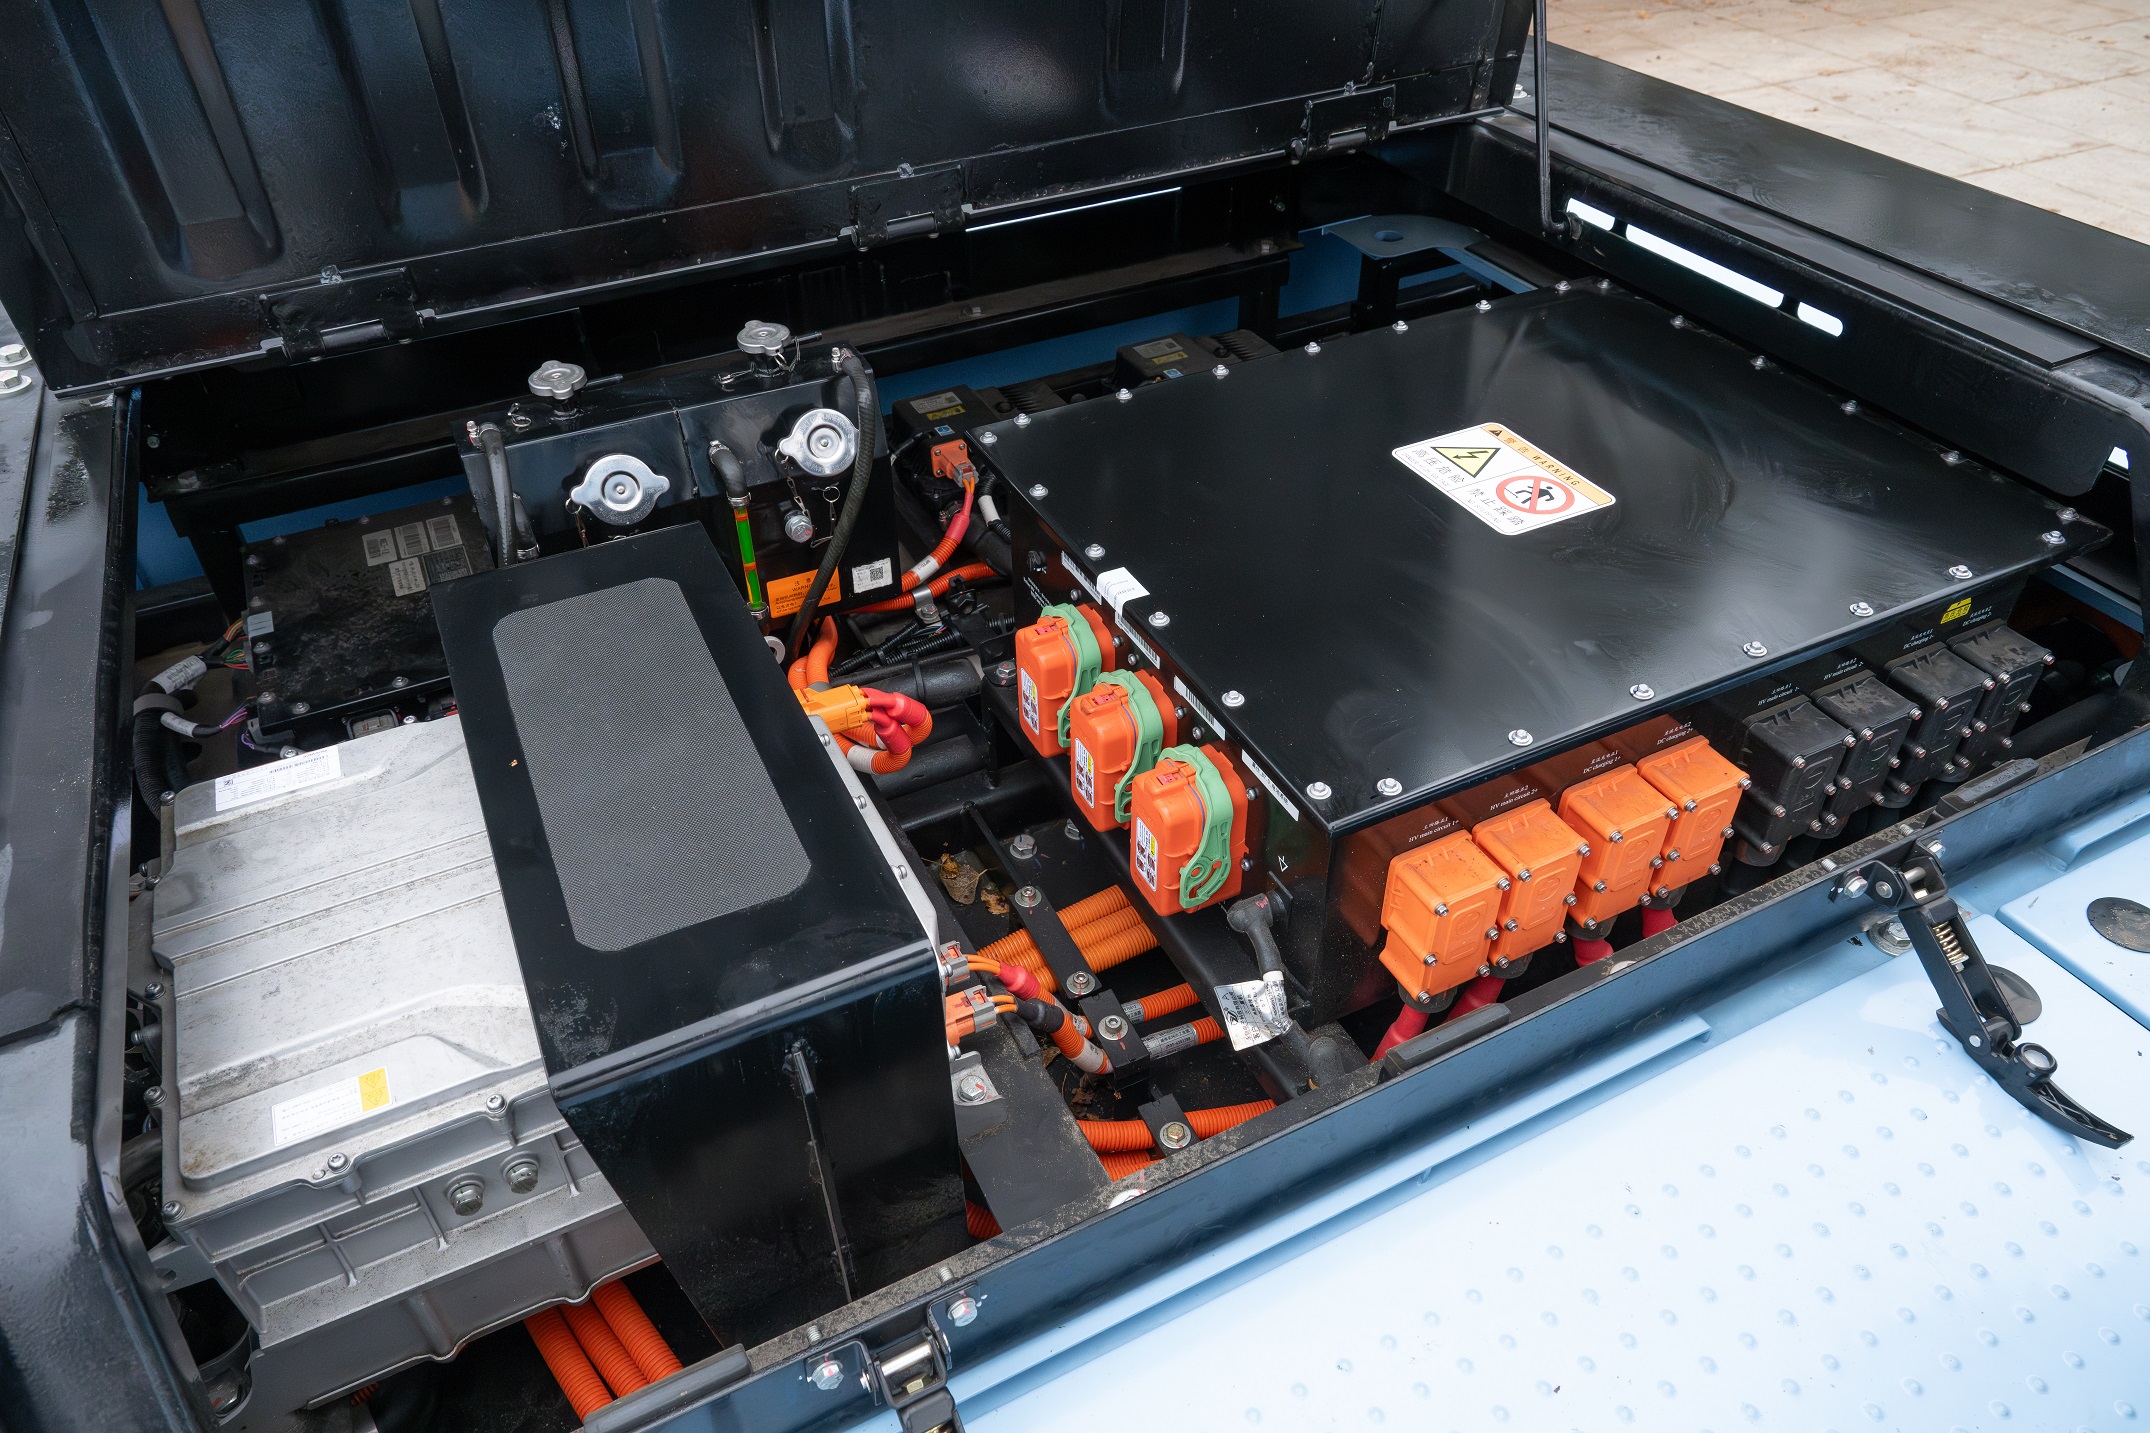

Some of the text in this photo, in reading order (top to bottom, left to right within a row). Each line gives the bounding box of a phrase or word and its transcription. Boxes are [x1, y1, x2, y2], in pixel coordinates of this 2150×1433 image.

[1412, 449, 1465, 484] 高压危险
[1533, 455, 1580, 486] WARNING
[1592, 759, 1614, 771] charging
[1489, 802, 1501, 811] HV
[1500, 798, 1514, 807] main
[1513, 792, 1531, 802] circuit
[1408, 835, 1419, 843] HV
[1419, 829, 1433, 839] main
[1433, 822, 1451, 833] circuit
